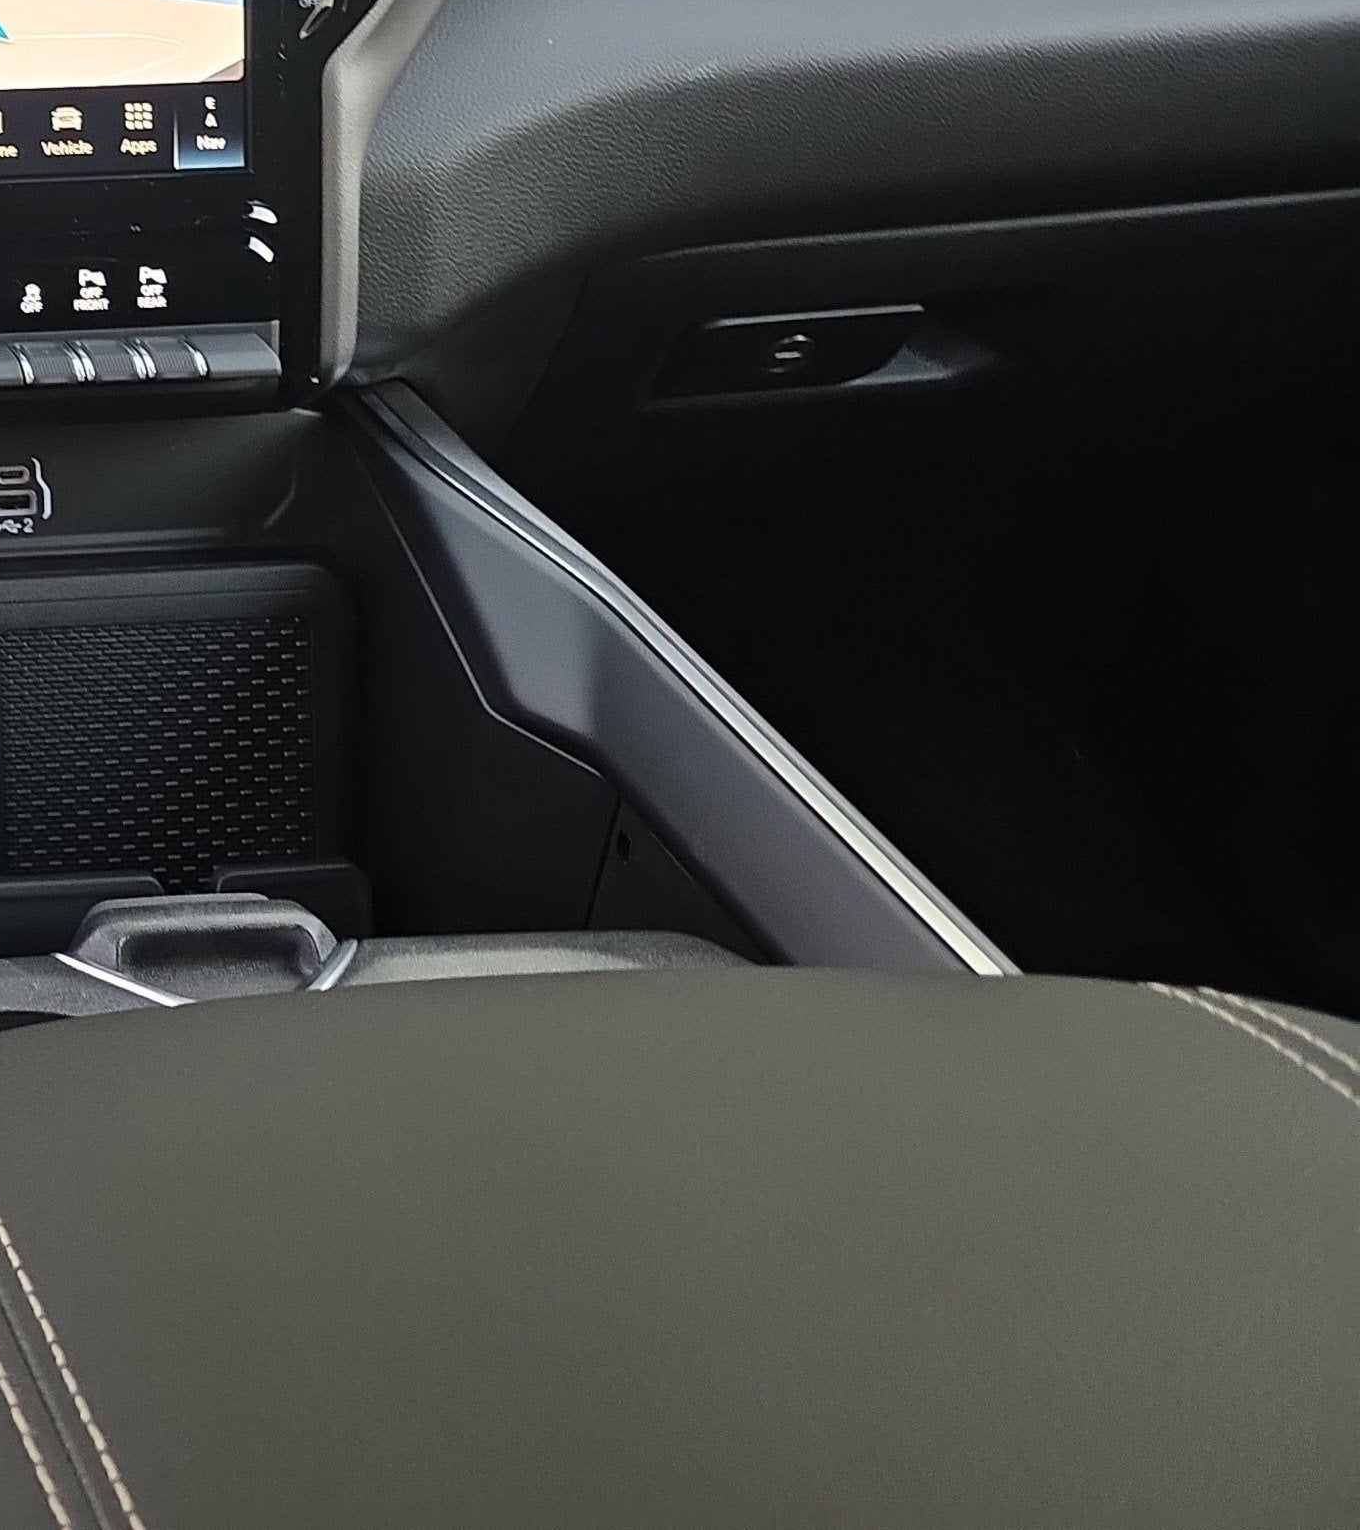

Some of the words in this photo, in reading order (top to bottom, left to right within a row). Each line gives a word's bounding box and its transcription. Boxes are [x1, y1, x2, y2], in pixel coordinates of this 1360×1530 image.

[40, 139, 94, 156] Vehicle
[120, 138, 158, 156] Apps
[196, 134, 227, 151] Nav
[72, 298, 110, 311] FRONT
